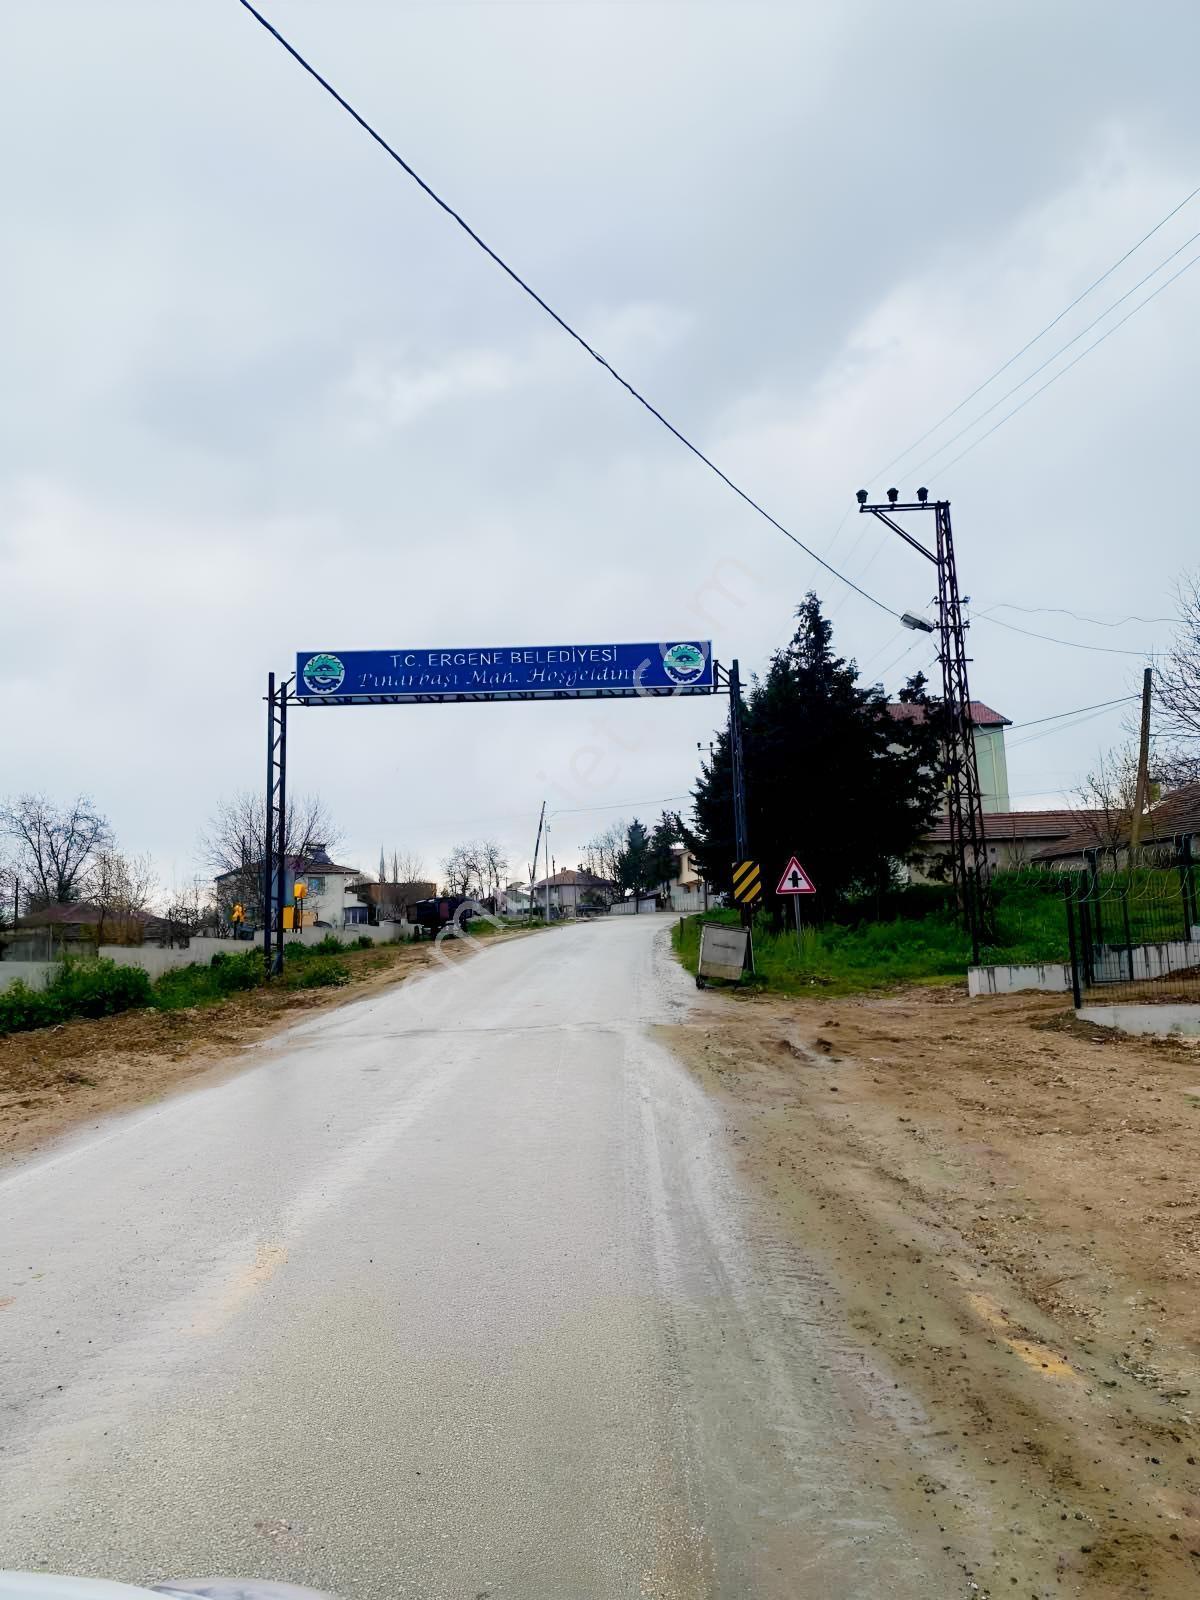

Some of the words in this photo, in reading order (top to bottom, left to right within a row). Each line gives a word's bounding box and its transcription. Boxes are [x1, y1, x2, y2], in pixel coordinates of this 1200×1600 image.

[389, 654, 423, 668] T.C.
[428, 652, 504, 667] ERGENE
[510, 645, 618, 664] BELEDİYESİ
